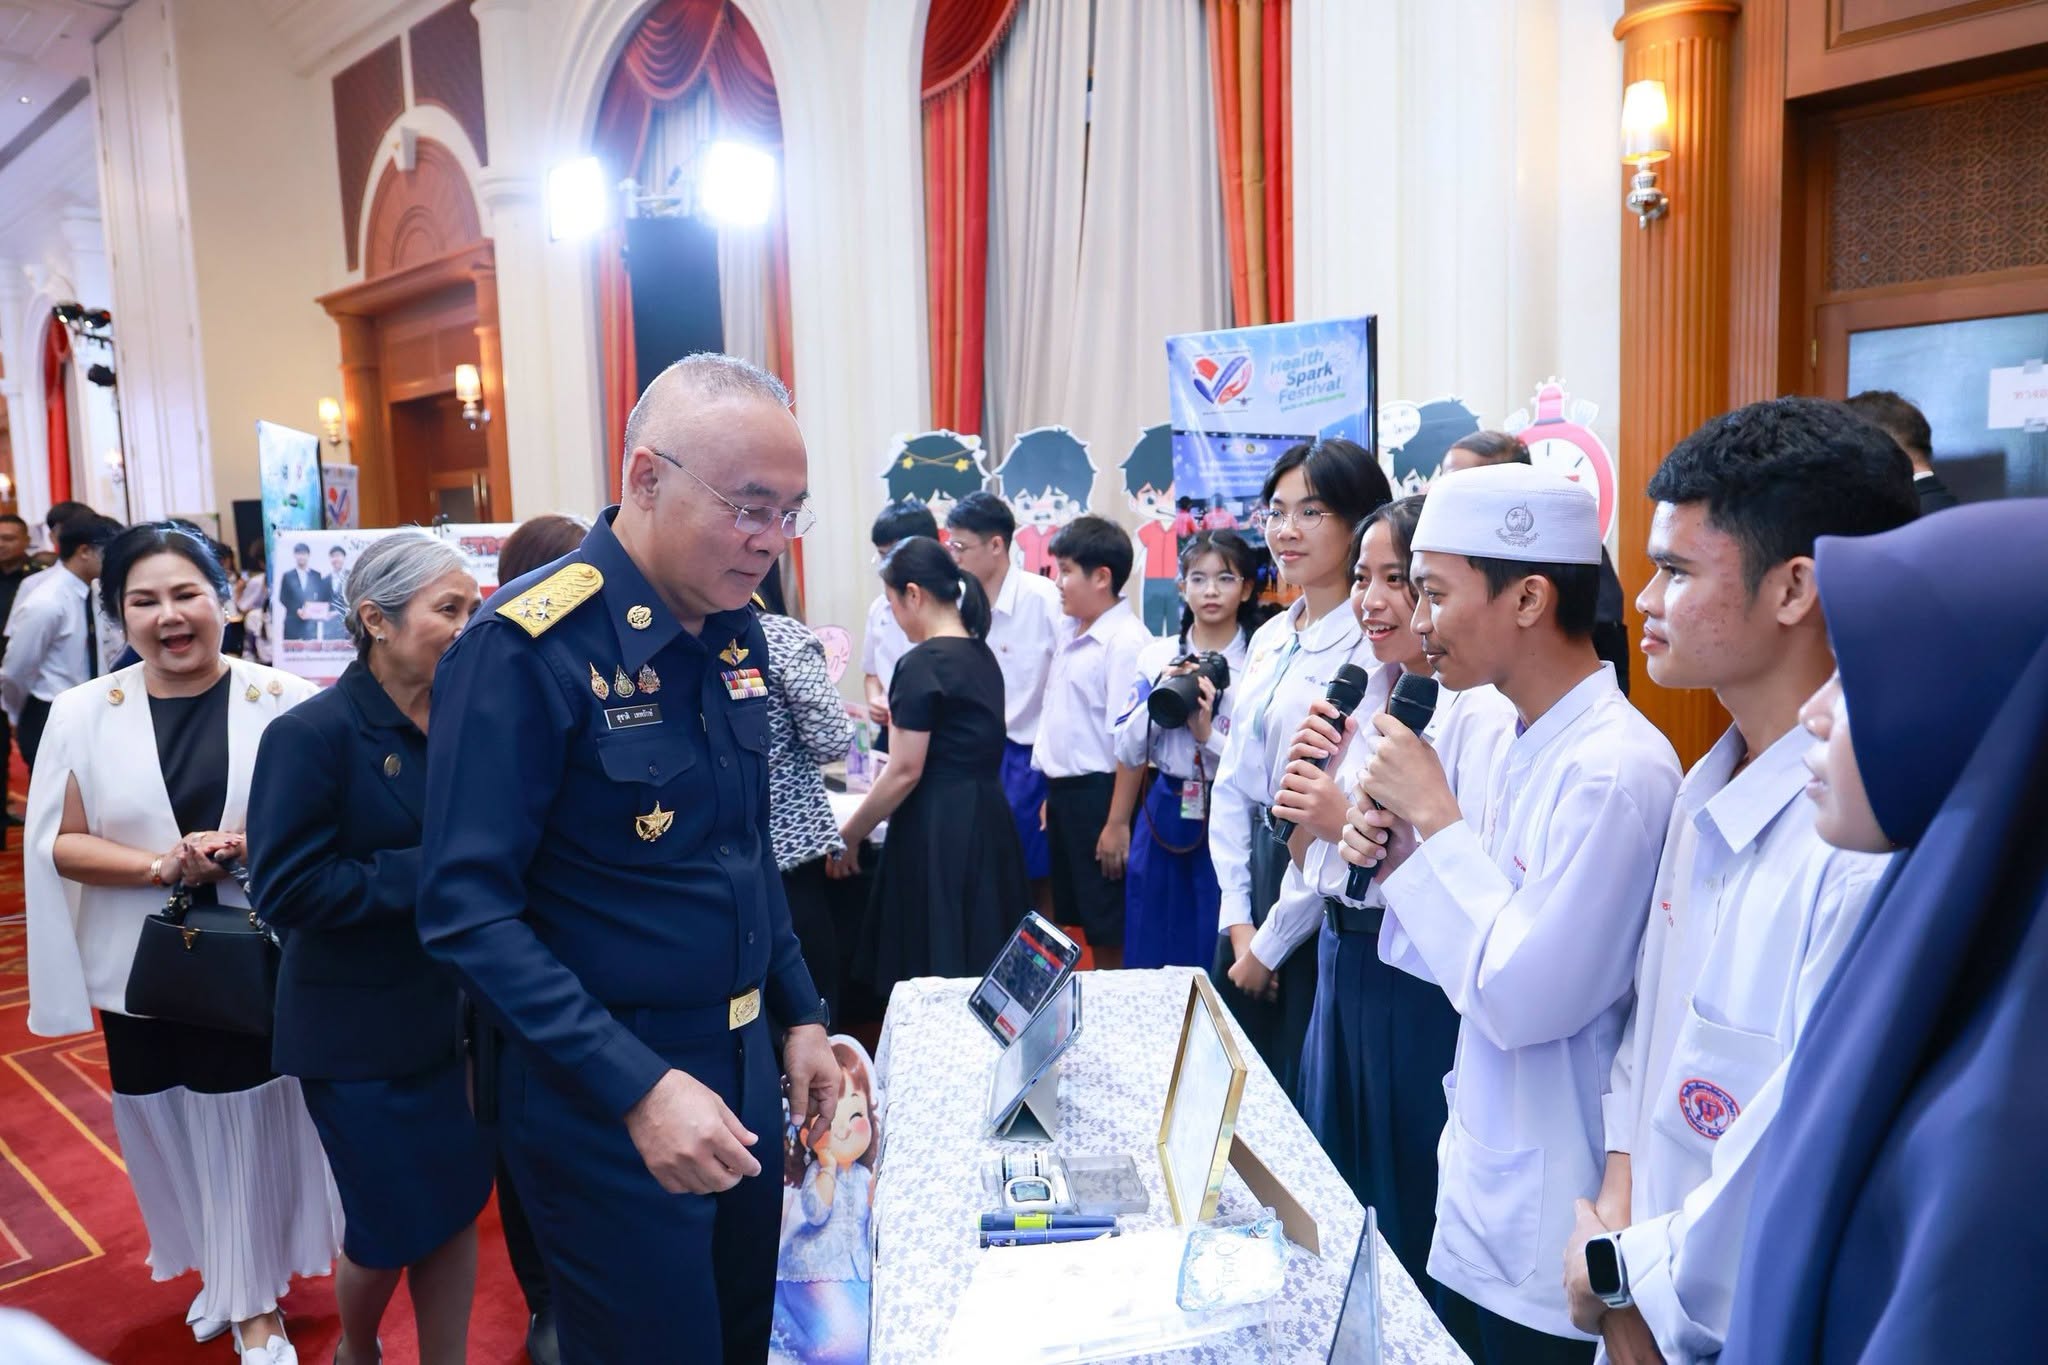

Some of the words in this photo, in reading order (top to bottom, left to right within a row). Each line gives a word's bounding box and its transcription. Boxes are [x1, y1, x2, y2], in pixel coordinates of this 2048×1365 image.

[1270, 348, 1324, 376] Health
[1286, 361, 1333, 387] Spark
[1279, 376, 1341, 404] Festival
